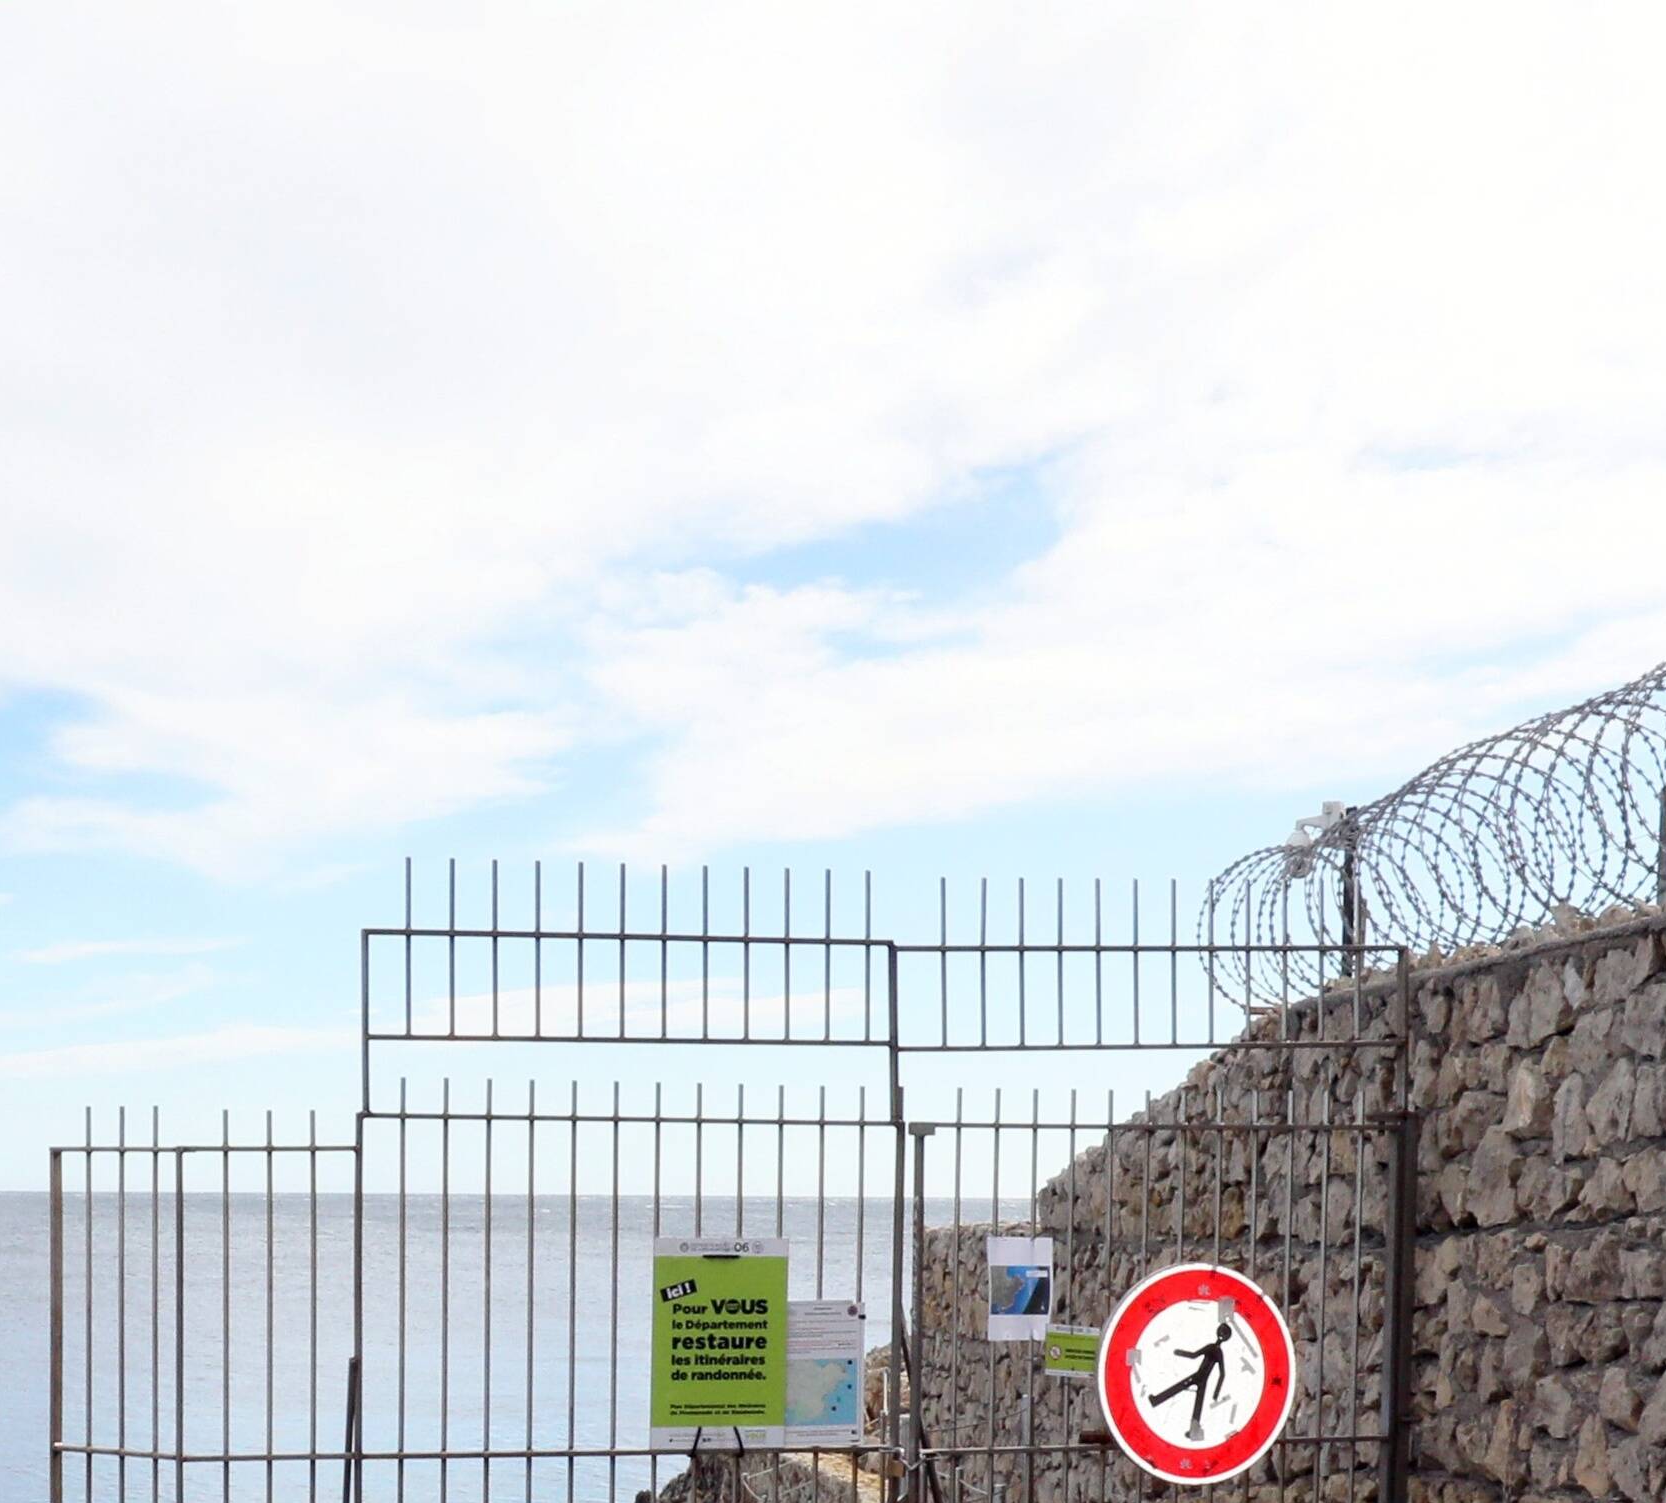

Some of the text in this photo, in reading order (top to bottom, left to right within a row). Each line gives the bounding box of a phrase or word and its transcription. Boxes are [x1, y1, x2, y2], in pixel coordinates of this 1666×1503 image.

[734, 1242, 749, 1252] 06
[673, 1303, 708, 1314] Pour
[710, 1299, 768, 1315] VOUS
[672, 1319, 768, 1331] le Département
[672, 1334, 767, 1350] restaure
[672, 1353, 766, 1366] les itinéraires
[671, 1367, 767, 1381] de randonnée.
